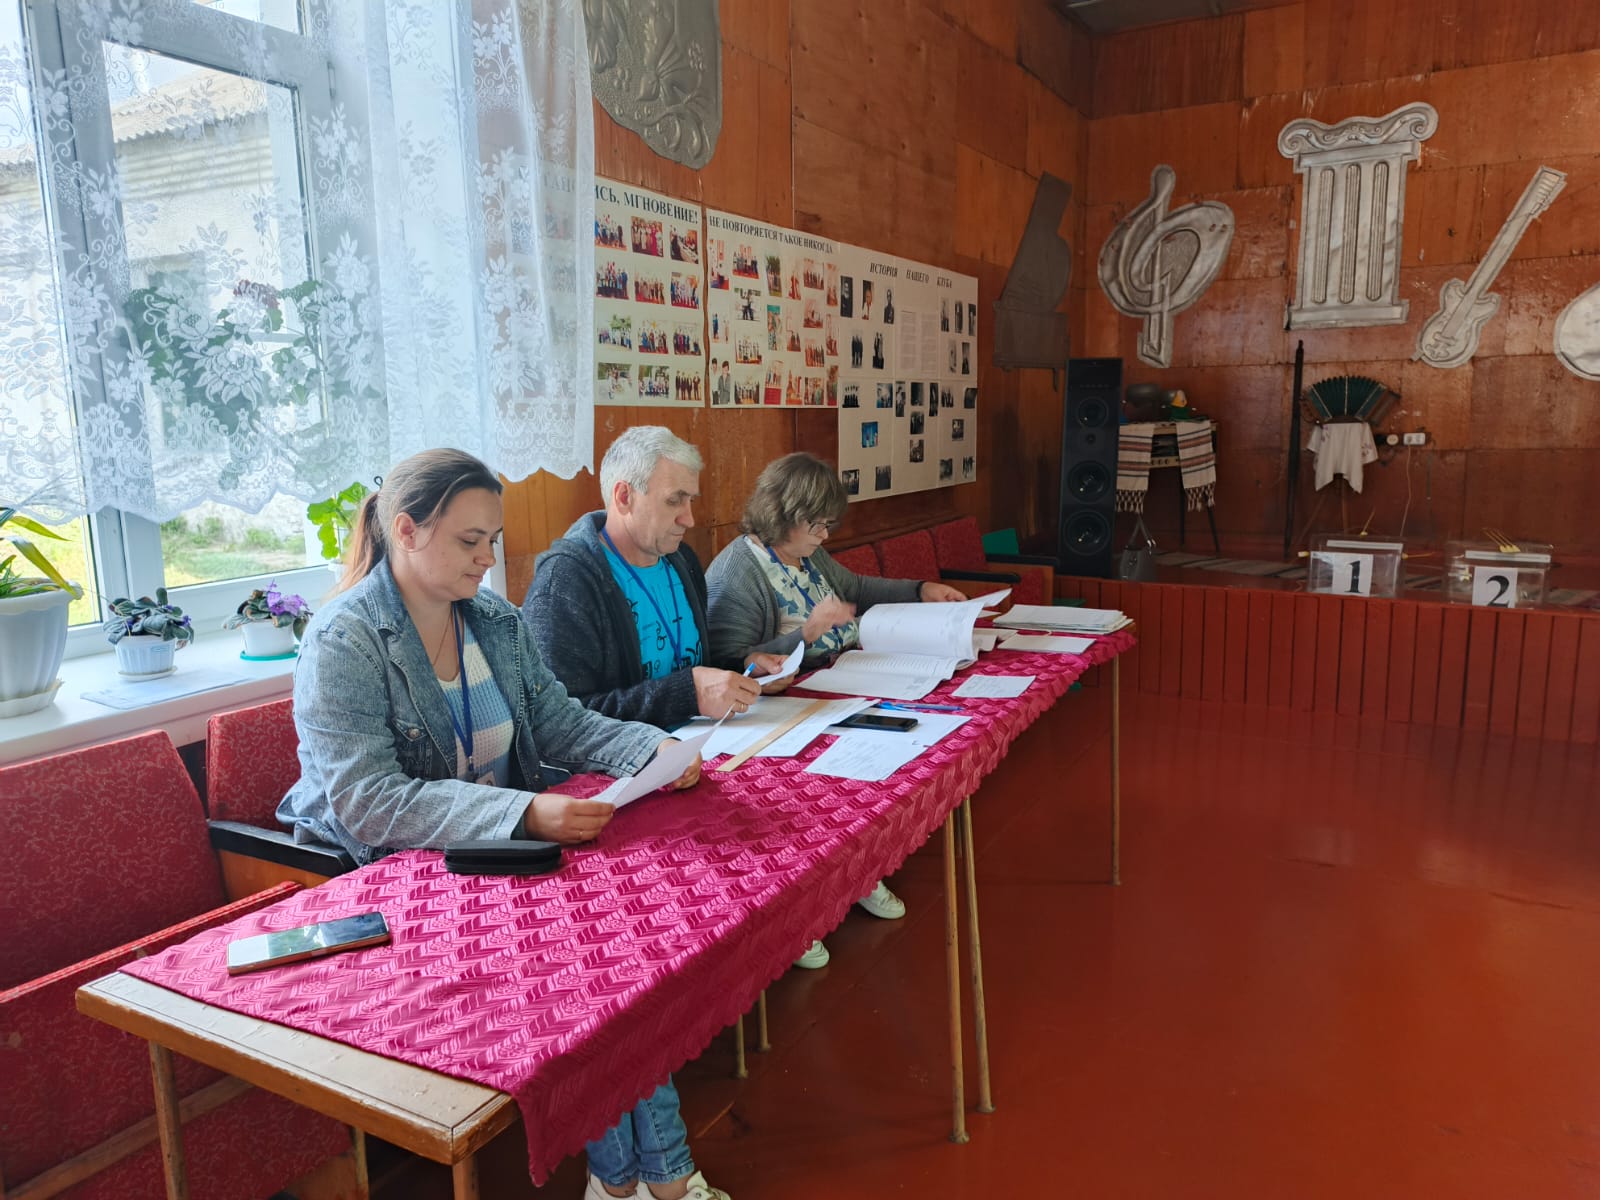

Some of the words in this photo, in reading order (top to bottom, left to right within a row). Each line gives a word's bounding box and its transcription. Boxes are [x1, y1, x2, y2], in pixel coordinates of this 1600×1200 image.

[623, 191, 698, 224] МГНОВЕНИЕ!
[709, 215, 720, 228] НЕ
[722, 218, 778, 241] ПОВТОРЯЕТСЯ
[779, 232, 803, 248] ТАКОЕ
[803, 237, 833, 254] НИКОГДА
[870, 262, 898, 278] ИСТОРИЯ
[906, 269, 929, 284] НАШЕГО
[1344, 560, 1364, 593] 1
[1486, 574, 1510, 608] 2
